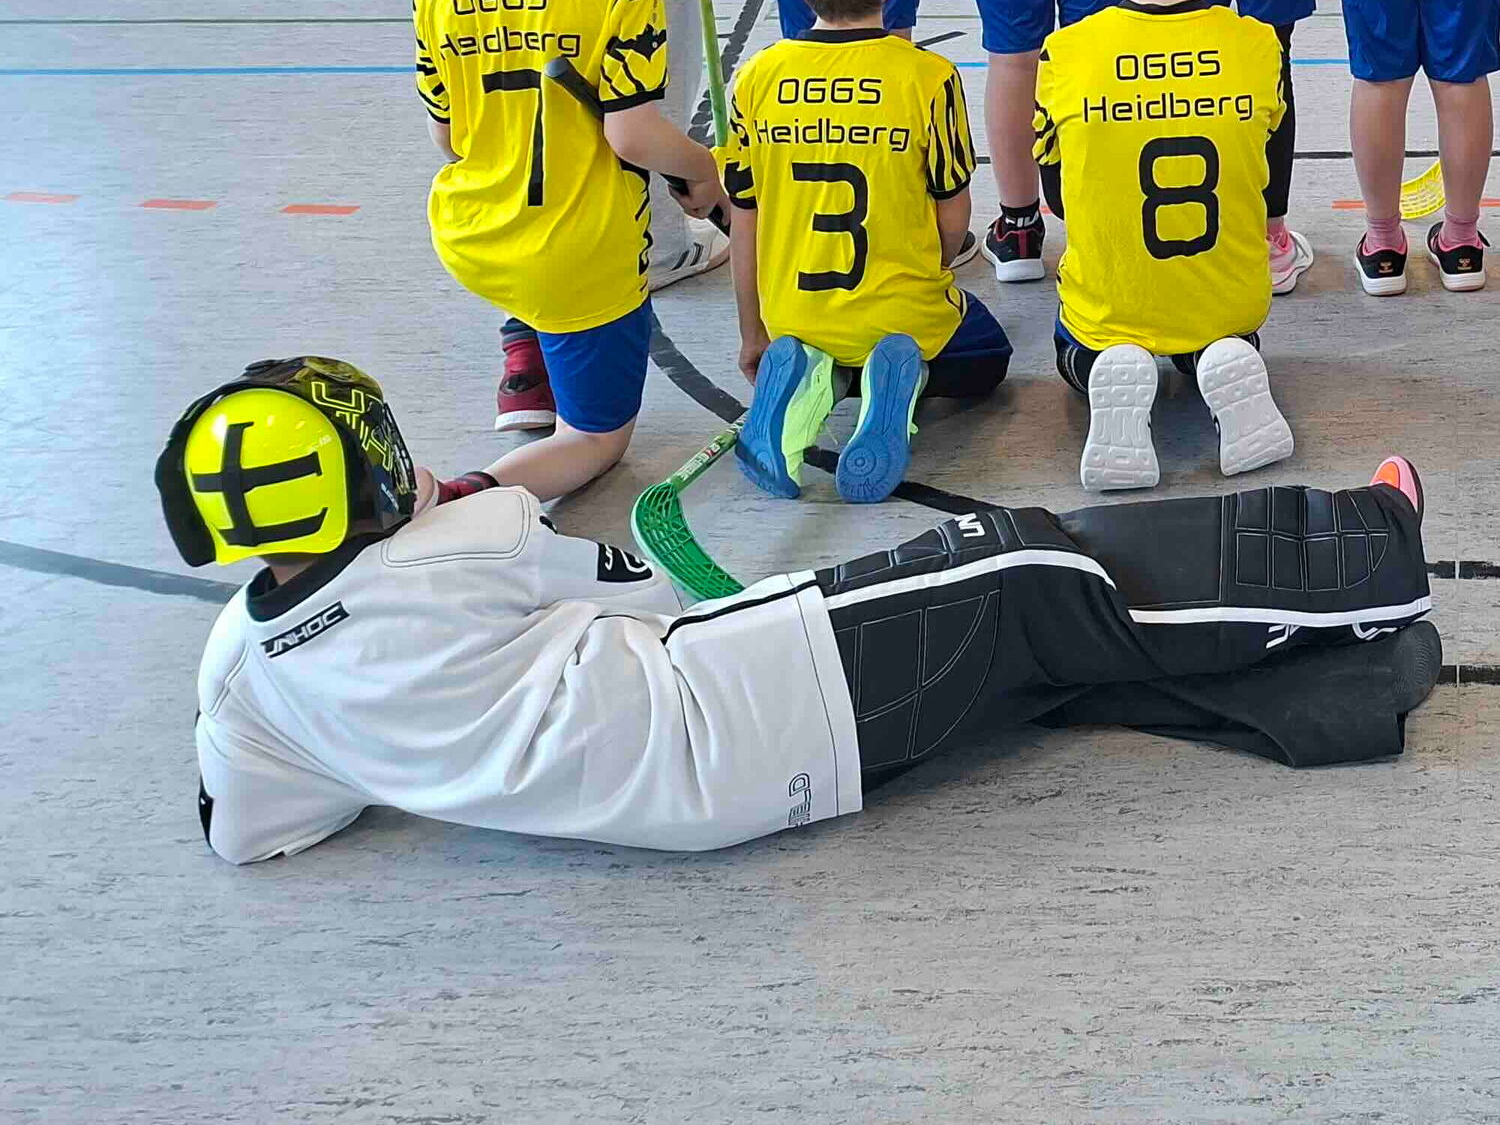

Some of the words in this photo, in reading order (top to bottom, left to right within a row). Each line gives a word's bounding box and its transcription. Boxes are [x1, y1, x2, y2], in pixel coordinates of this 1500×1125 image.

[1115, 50, 1221, 81] OGGS
[777, 77, 882, 105] OGGS
[1083, 92, 1253, 123] Heidberg
[481, 67, 545, 207] 7
[756, 118, 910, 152] Heidberg
[1138, 135, 1220, 260] 8
[791, 162, 869, 292] 3
